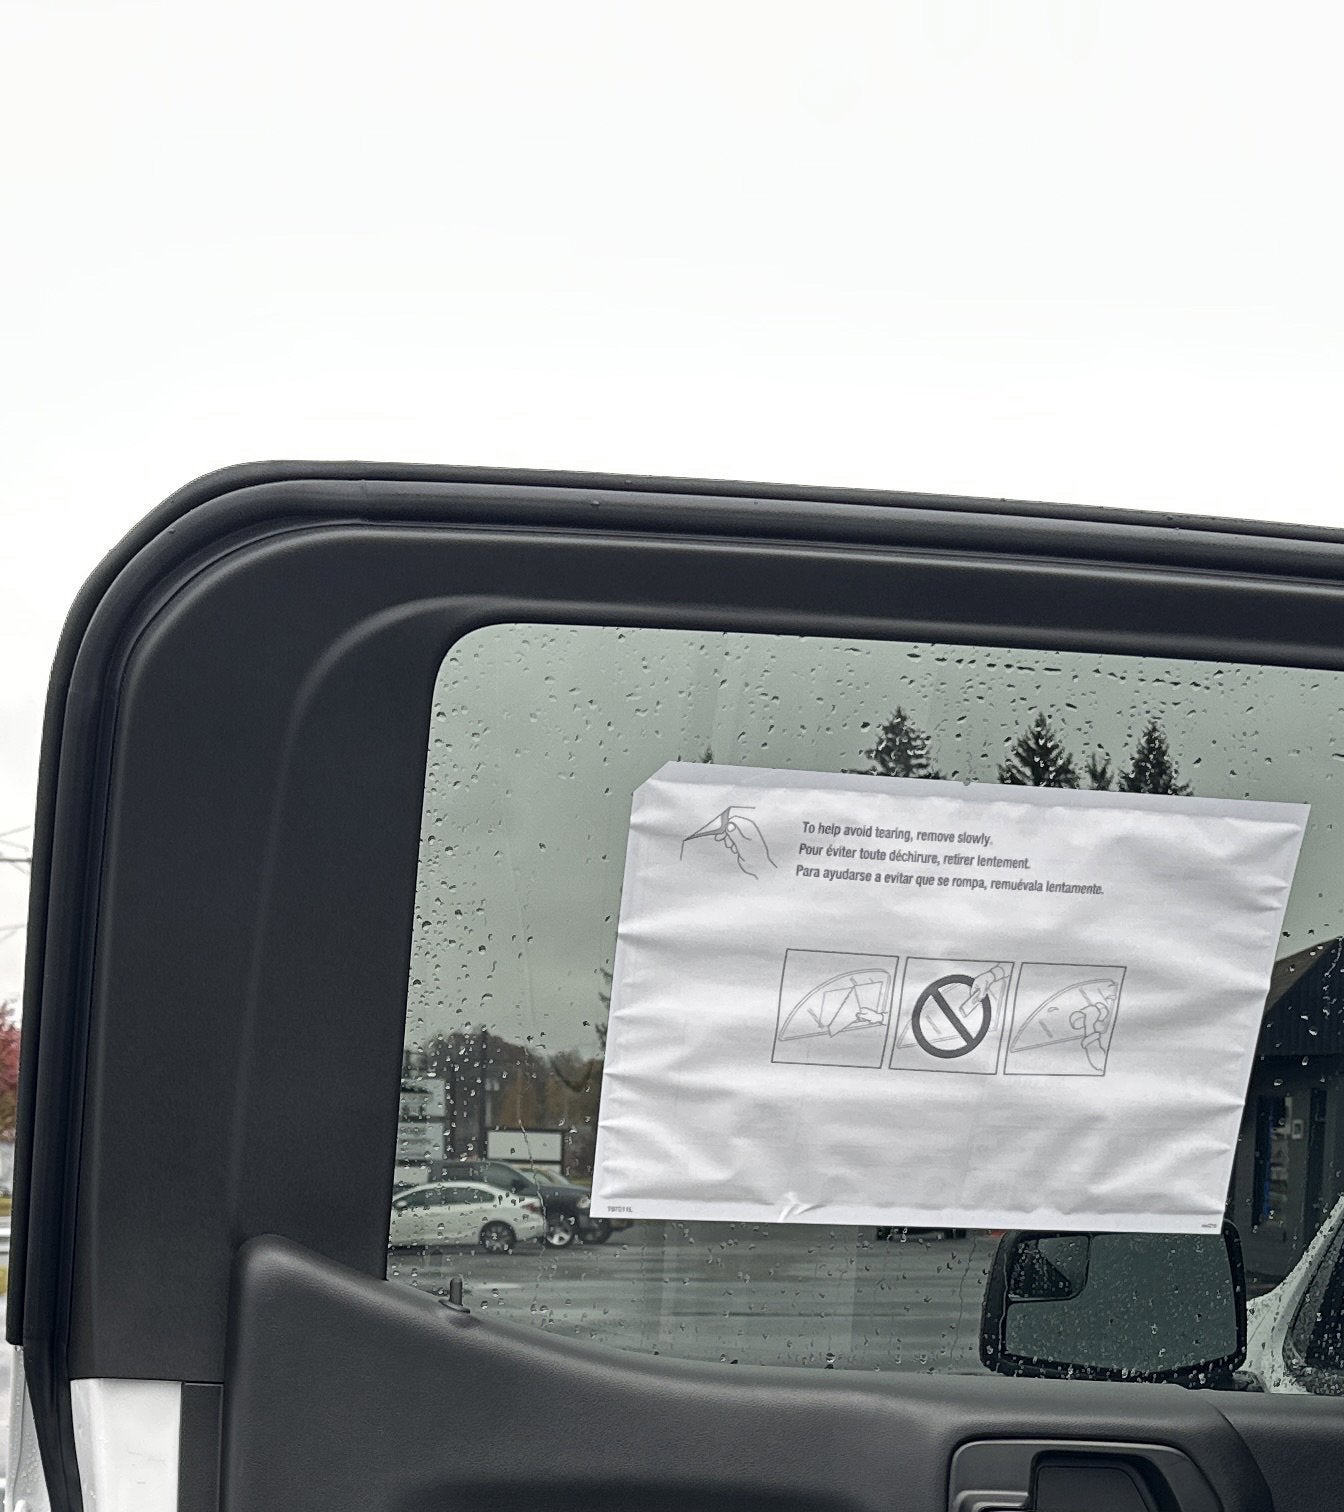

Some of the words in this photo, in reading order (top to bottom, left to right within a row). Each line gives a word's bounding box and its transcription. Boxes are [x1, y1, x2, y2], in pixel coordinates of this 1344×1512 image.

[803, 821, 815, 834] To
[818, 822, 841, 837] help
[843, 825, 872, 838] avoid
[875, 826, 914, 842] tearing,
[916, 831, 955, 842] remove
[957, 832, 993, 847] slowly.
[799, 843, 823, 855] Pour
[826, 844, 857, 858] éviter
[859, 848, 886, 860] toute
[889, 849, 940, 866] déchirure,
[942, 853, 975, 866] retirer
[976, 855, 1031, 869] lentement.
[796, 864, 820, 877] Para
[822, 868, 872, 882] ayudarse
[874, 873, 881, 883] a
[884, 872, 914, 884] evitar
[915, 875, 935, 887] que
[937, 876, 950, 887] se
[952, 877, 987, 890] rompa,
[990, 879, 1043, 892] remuévala
[1045, 881, 1104, 895] lentamente.
